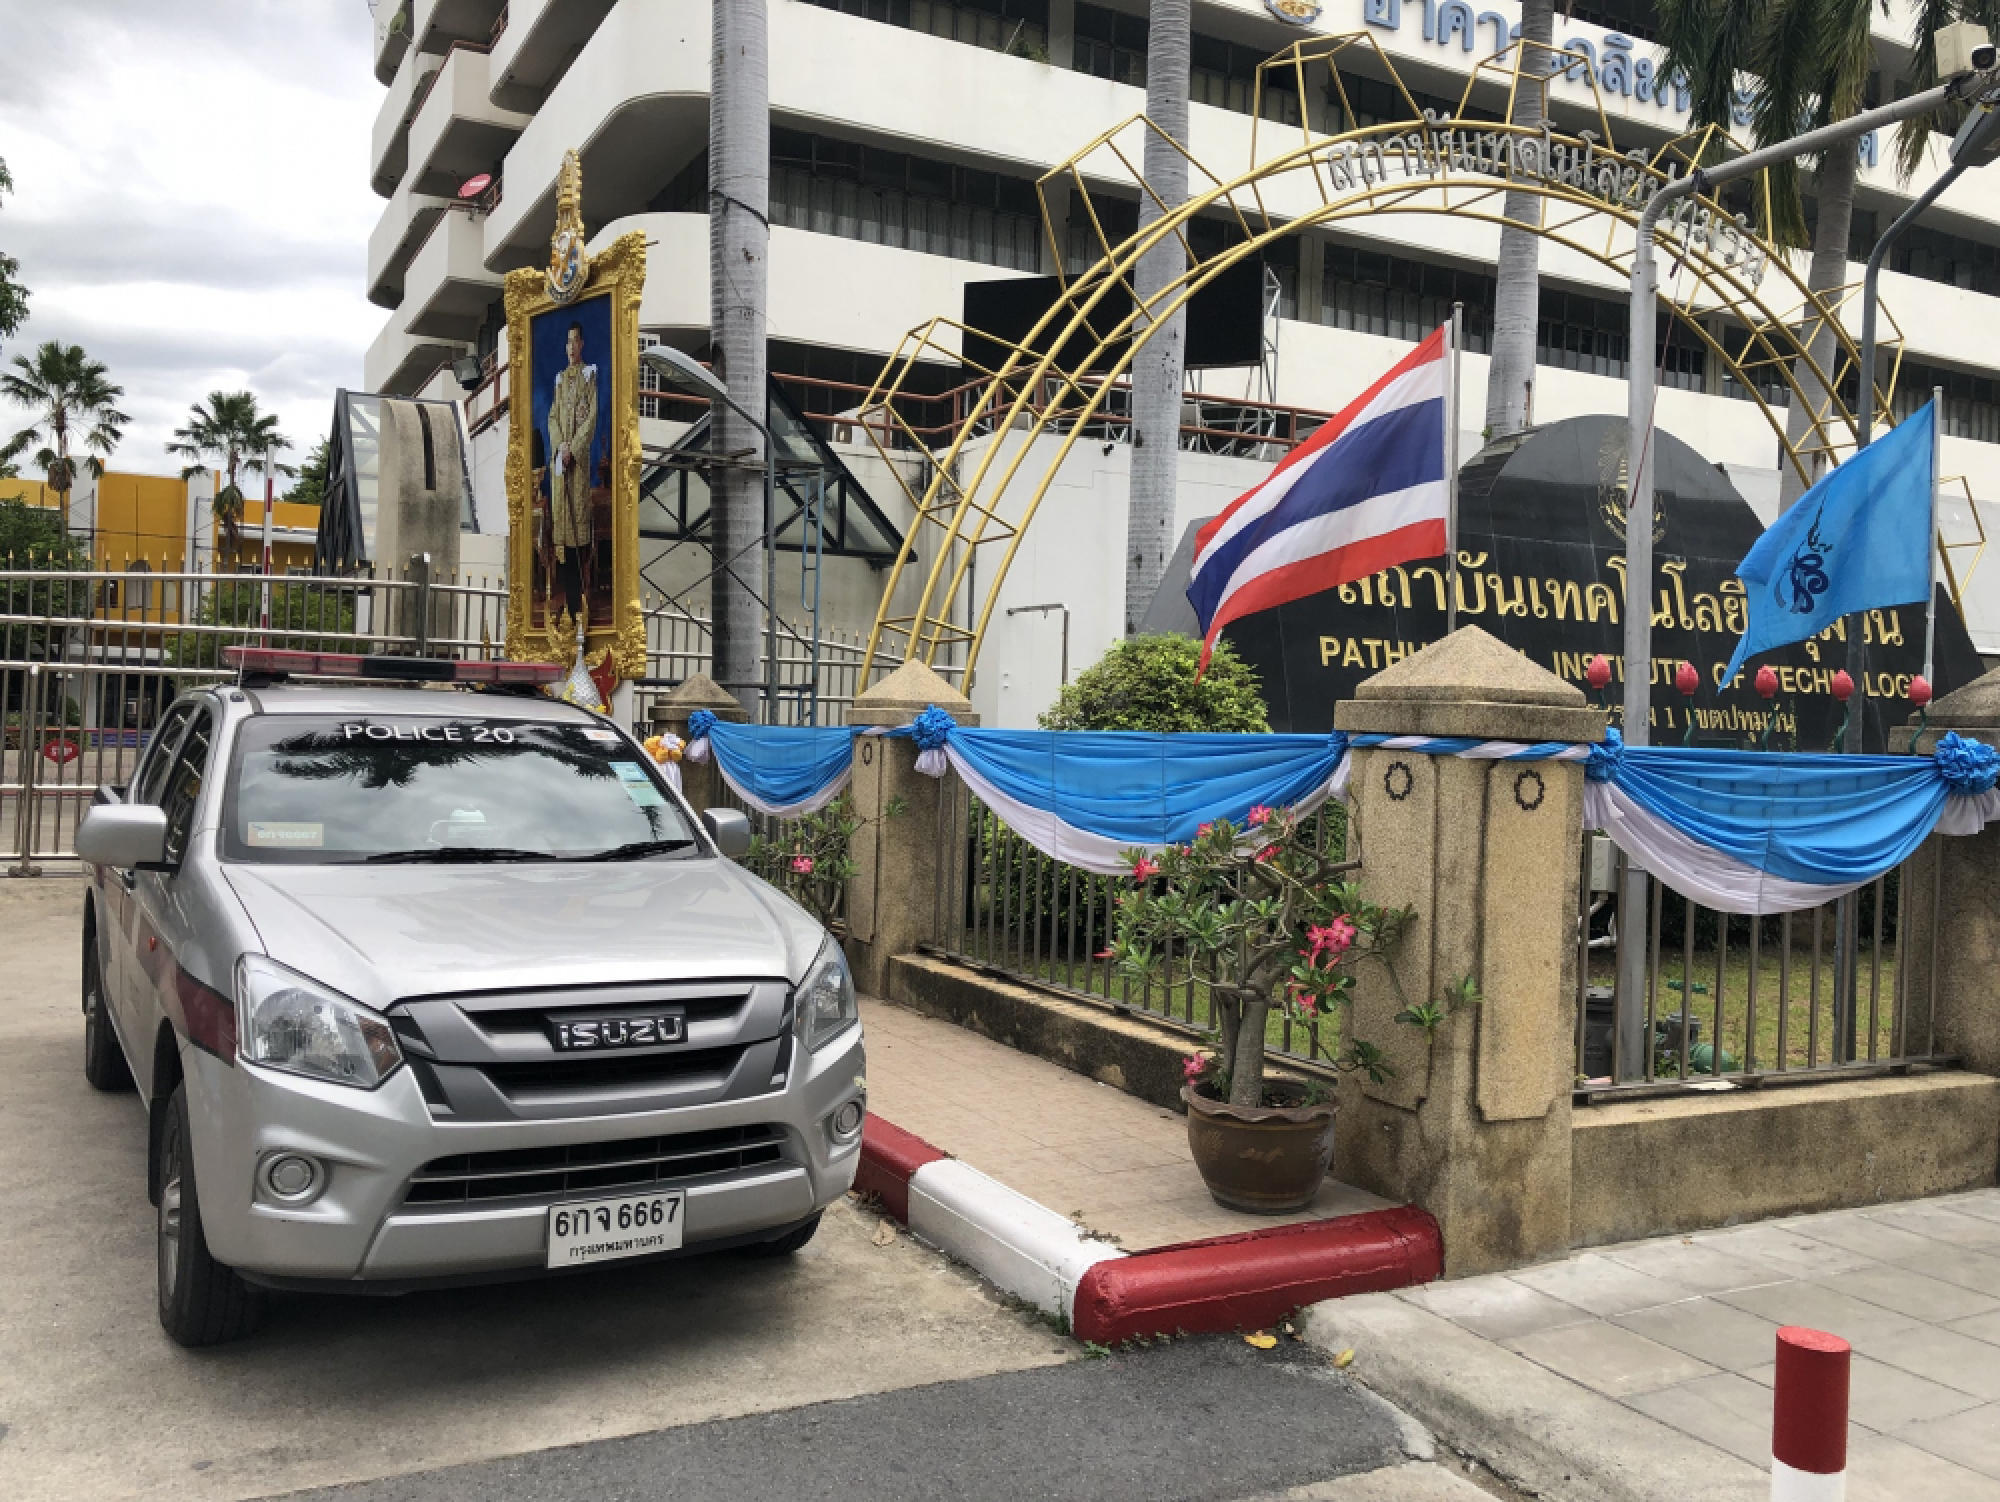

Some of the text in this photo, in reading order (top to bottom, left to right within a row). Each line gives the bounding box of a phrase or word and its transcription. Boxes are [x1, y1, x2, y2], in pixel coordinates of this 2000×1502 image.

[344, 725, 515, 743] POLICE 20
[559, 1017, 682, 1048] ISUZU
[617, 1197, 681, 1230] 6667
